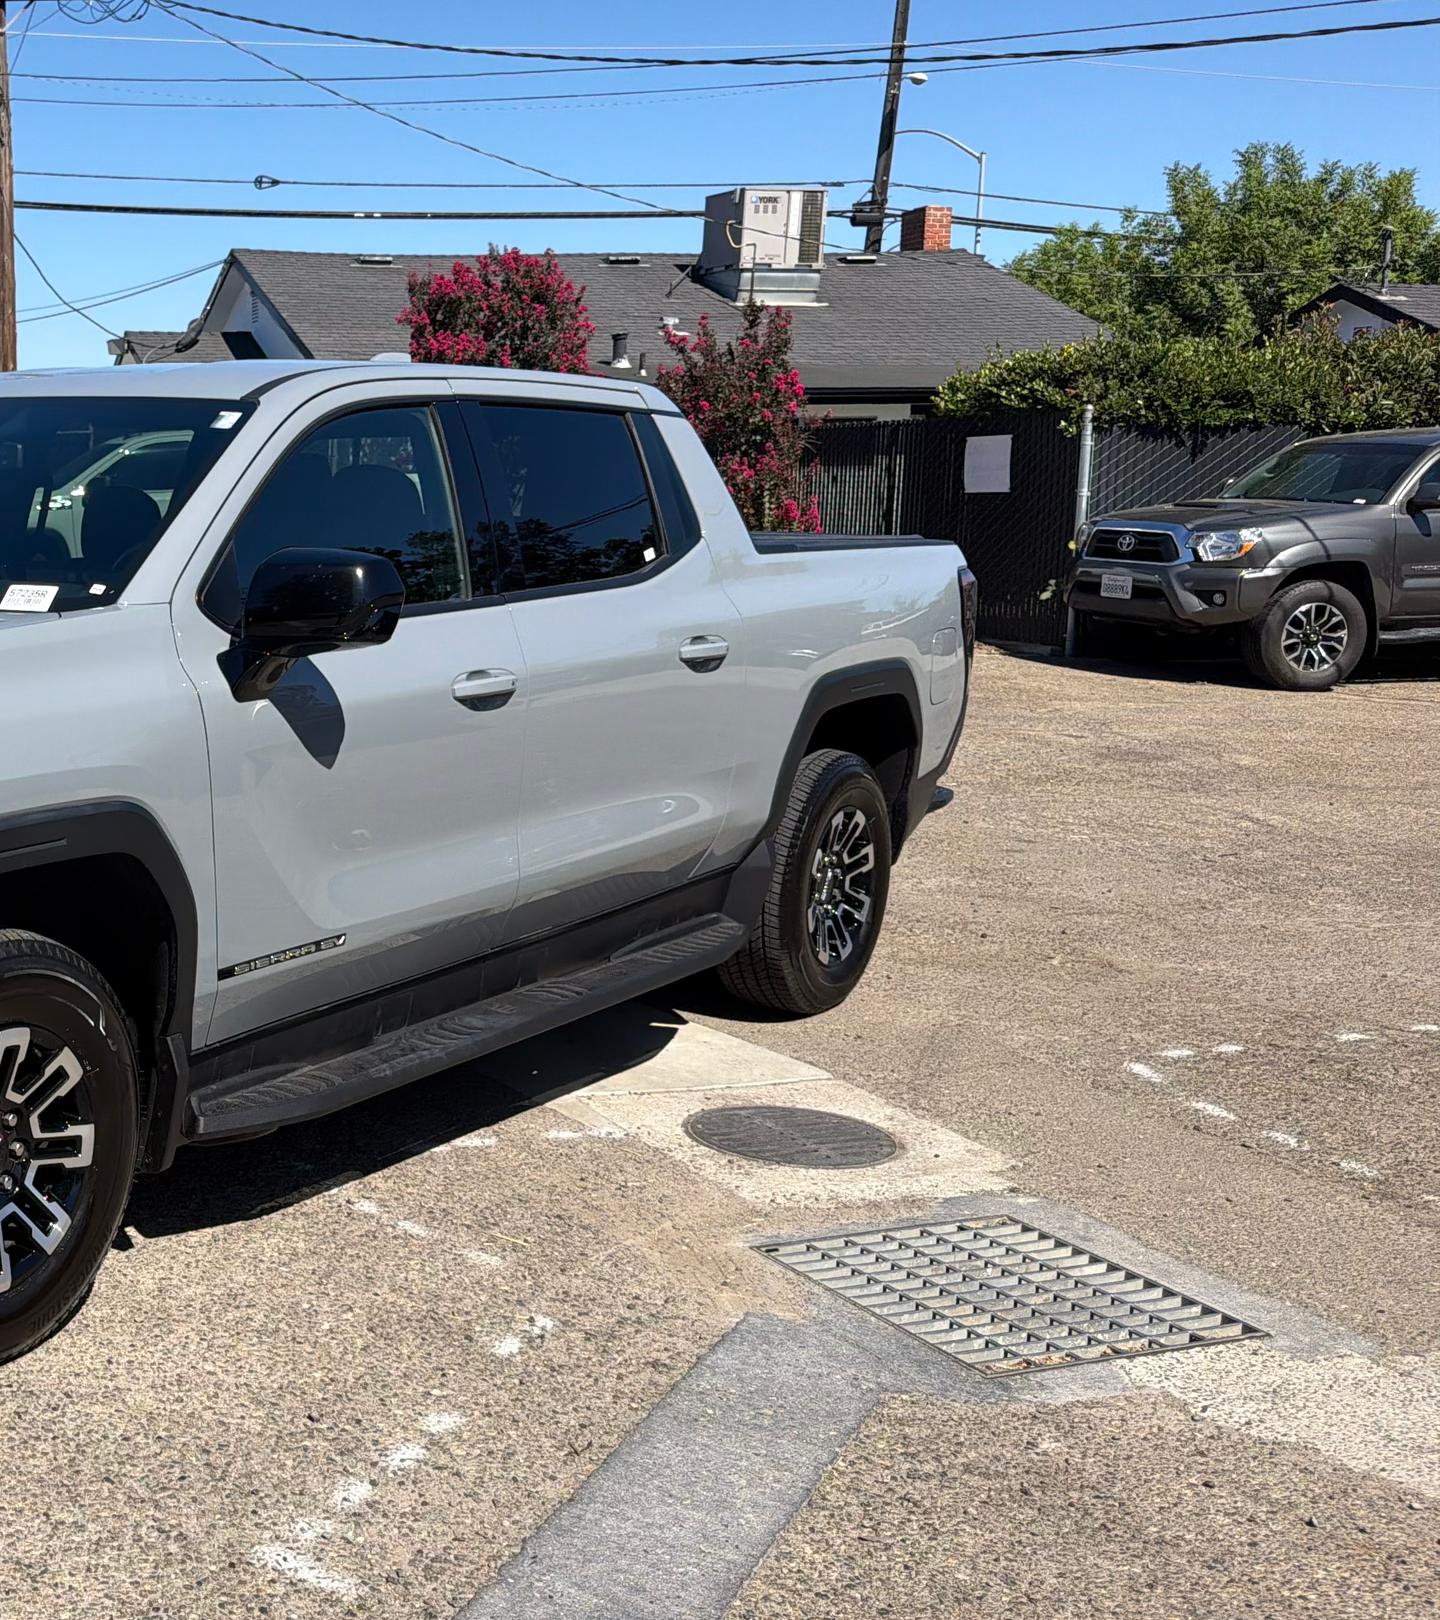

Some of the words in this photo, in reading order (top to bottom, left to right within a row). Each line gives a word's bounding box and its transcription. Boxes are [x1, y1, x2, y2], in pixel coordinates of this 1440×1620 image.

[758, 196, 779, 204] YORK
[234, 943, 316, 975] SIERRA
[320, 934, 346, 949] EV
